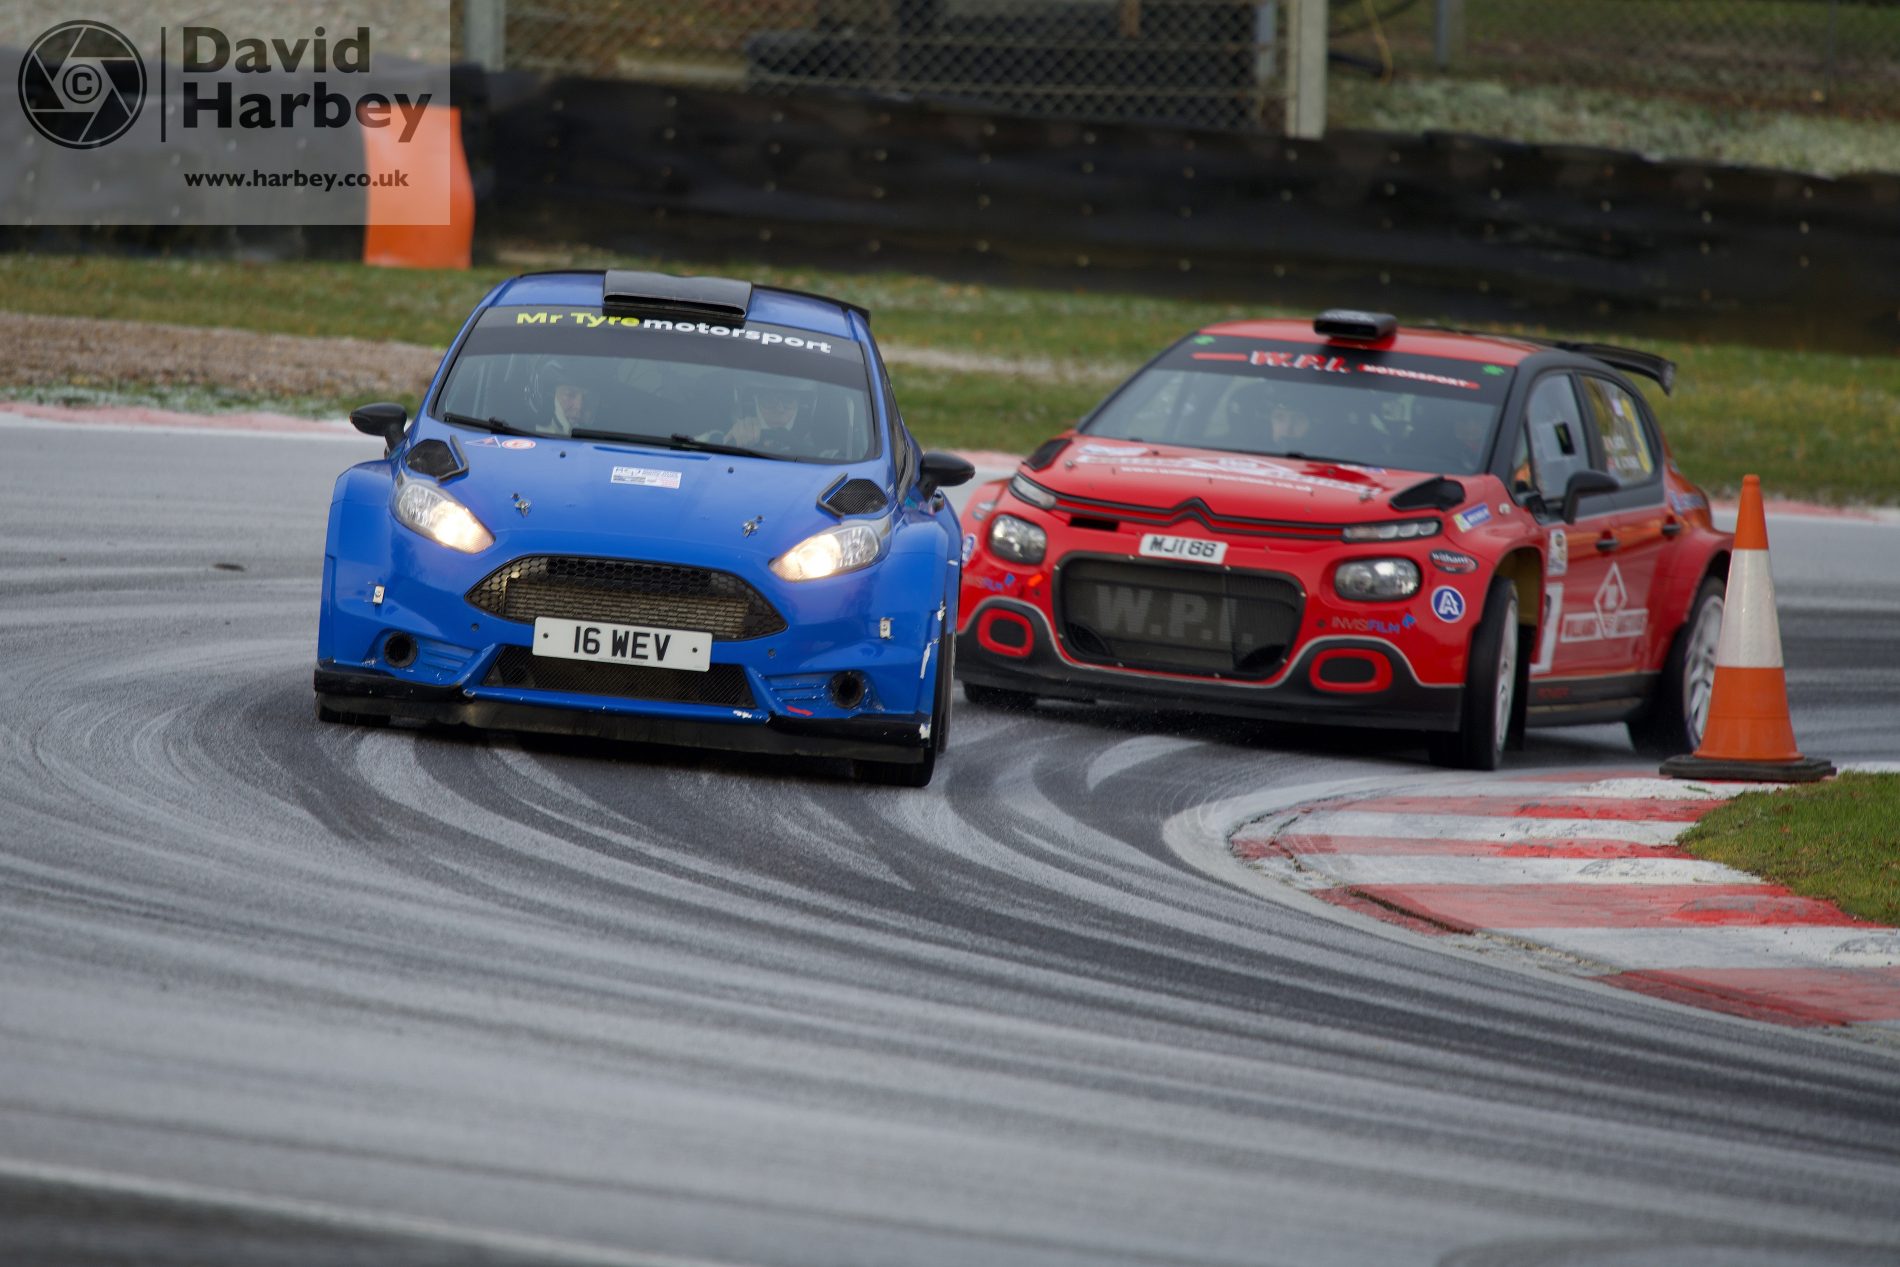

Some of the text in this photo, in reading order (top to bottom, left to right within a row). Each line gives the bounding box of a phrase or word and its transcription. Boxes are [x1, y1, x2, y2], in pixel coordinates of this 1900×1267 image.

[517, 312, 563, 325] Mr
[573, 626, 671, 661] 16 WEV
